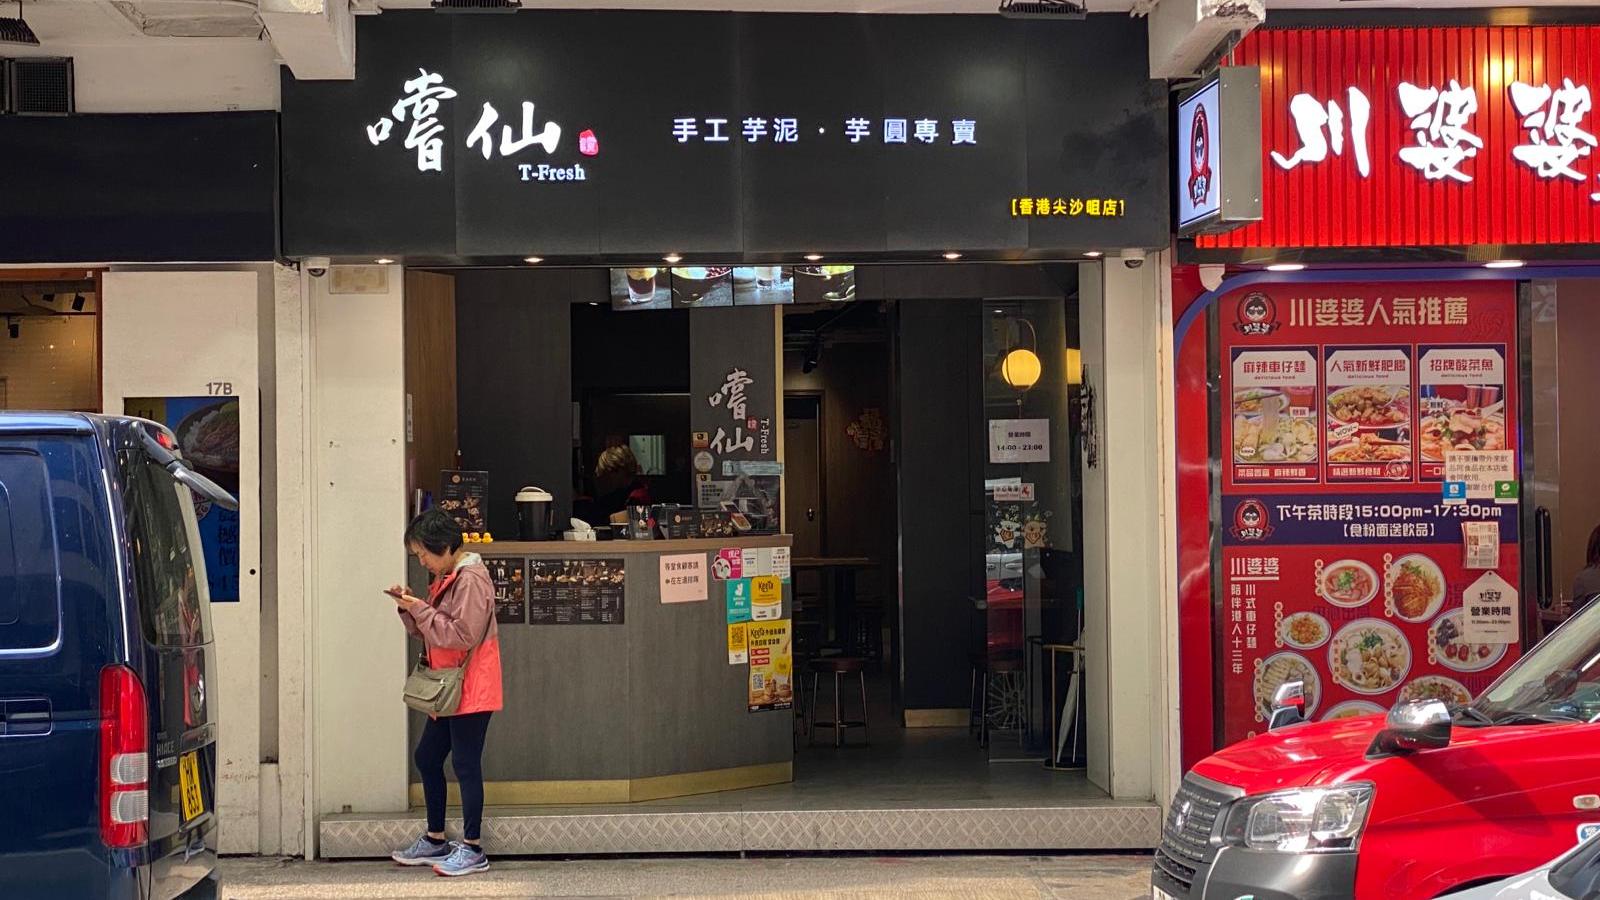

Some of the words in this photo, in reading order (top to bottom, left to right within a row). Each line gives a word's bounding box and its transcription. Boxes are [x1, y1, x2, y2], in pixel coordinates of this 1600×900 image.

[1271, 77, 1598, 184] 川婆婆
[518, 164, 586, 181] T-Fresh
[1289, 297, 1468, 326] 川婆婆人氣推薦
[1430, 358, 1493, 372] 招牌酸菜魚
[205, 382, 233, 396] 17B
[760, 418, 770, 455] T-Fresh
[1231, 557, 1279, 575] 川婆婆
[1470, 606, 1512, 617] 營業時間
[1231, 584, 1243, 674] 陪伴港人十三年
